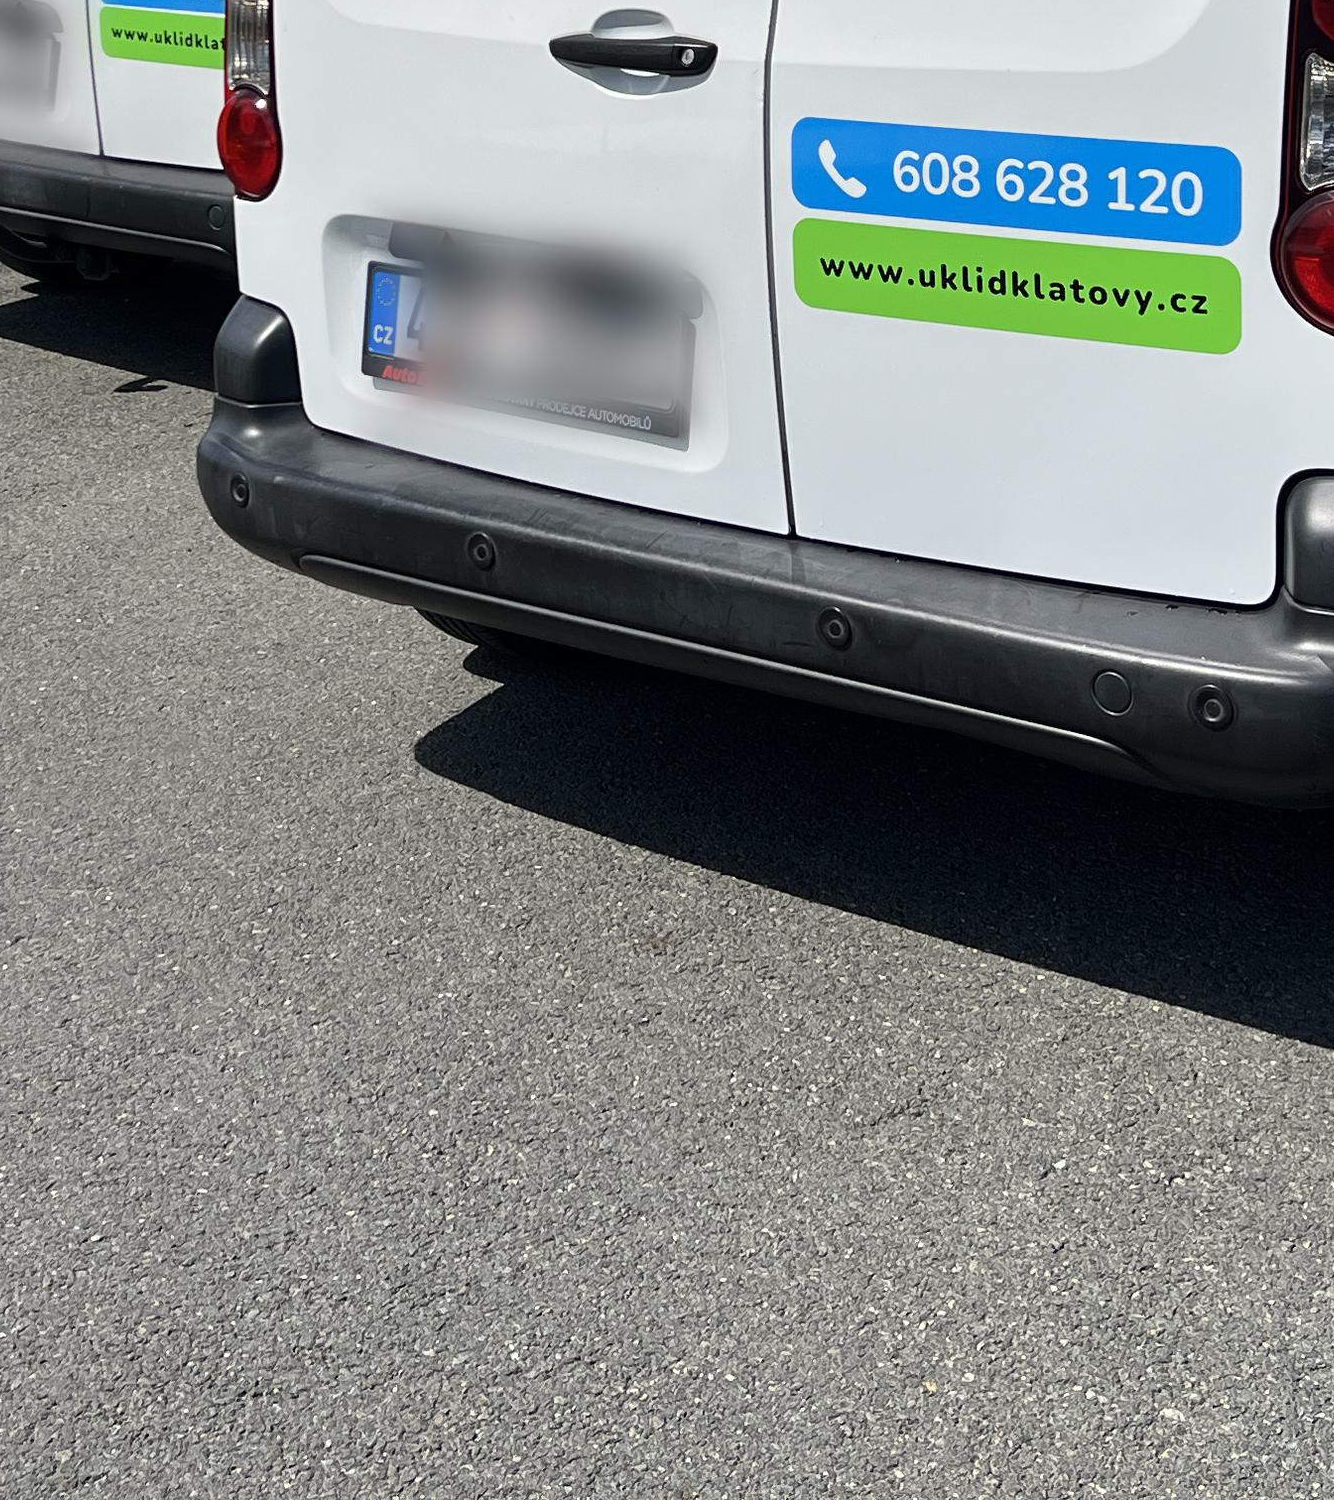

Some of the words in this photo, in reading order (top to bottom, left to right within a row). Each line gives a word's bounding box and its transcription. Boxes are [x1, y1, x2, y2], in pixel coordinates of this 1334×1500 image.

[893, 149, 981, 199] 608
[995, 158, 1089, 208] 628
[1107, 166, 1204, 217] 120
[820, 257, 1209, 317] www.uklidklatovy.cz
[373, 323, 394, 345] CZ
[536, 399, 586, 418] PRODEJCE
[587, 408, 652, 431] AUTOMOBILŮ
